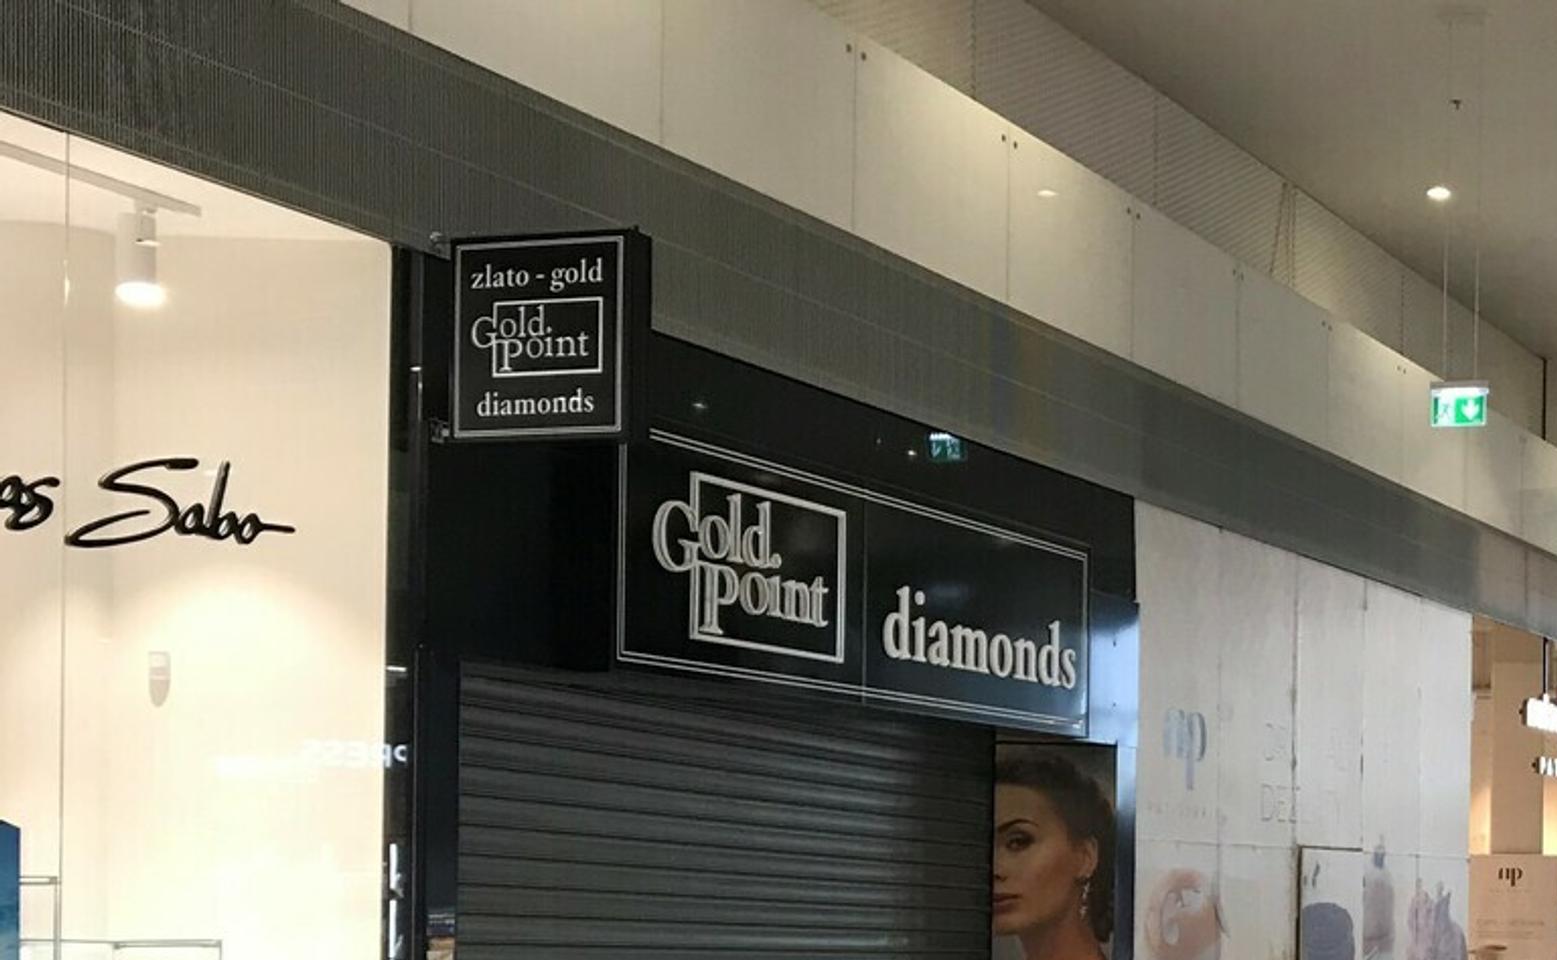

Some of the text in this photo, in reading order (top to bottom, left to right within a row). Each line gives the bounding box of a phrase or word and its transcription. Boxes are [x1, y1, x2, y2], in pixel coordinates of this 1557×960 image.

[471, 263, 530, 290] zlato
[549, 257, 604, 292] gold
[471, 304, 546, 349] Gold
[476, 387, 595, 417] diamonds
[64, 457, 296, 548] Sabo
[652, 492, 774, 573] Gold
[882, 584, 1077, 691] diamonds
